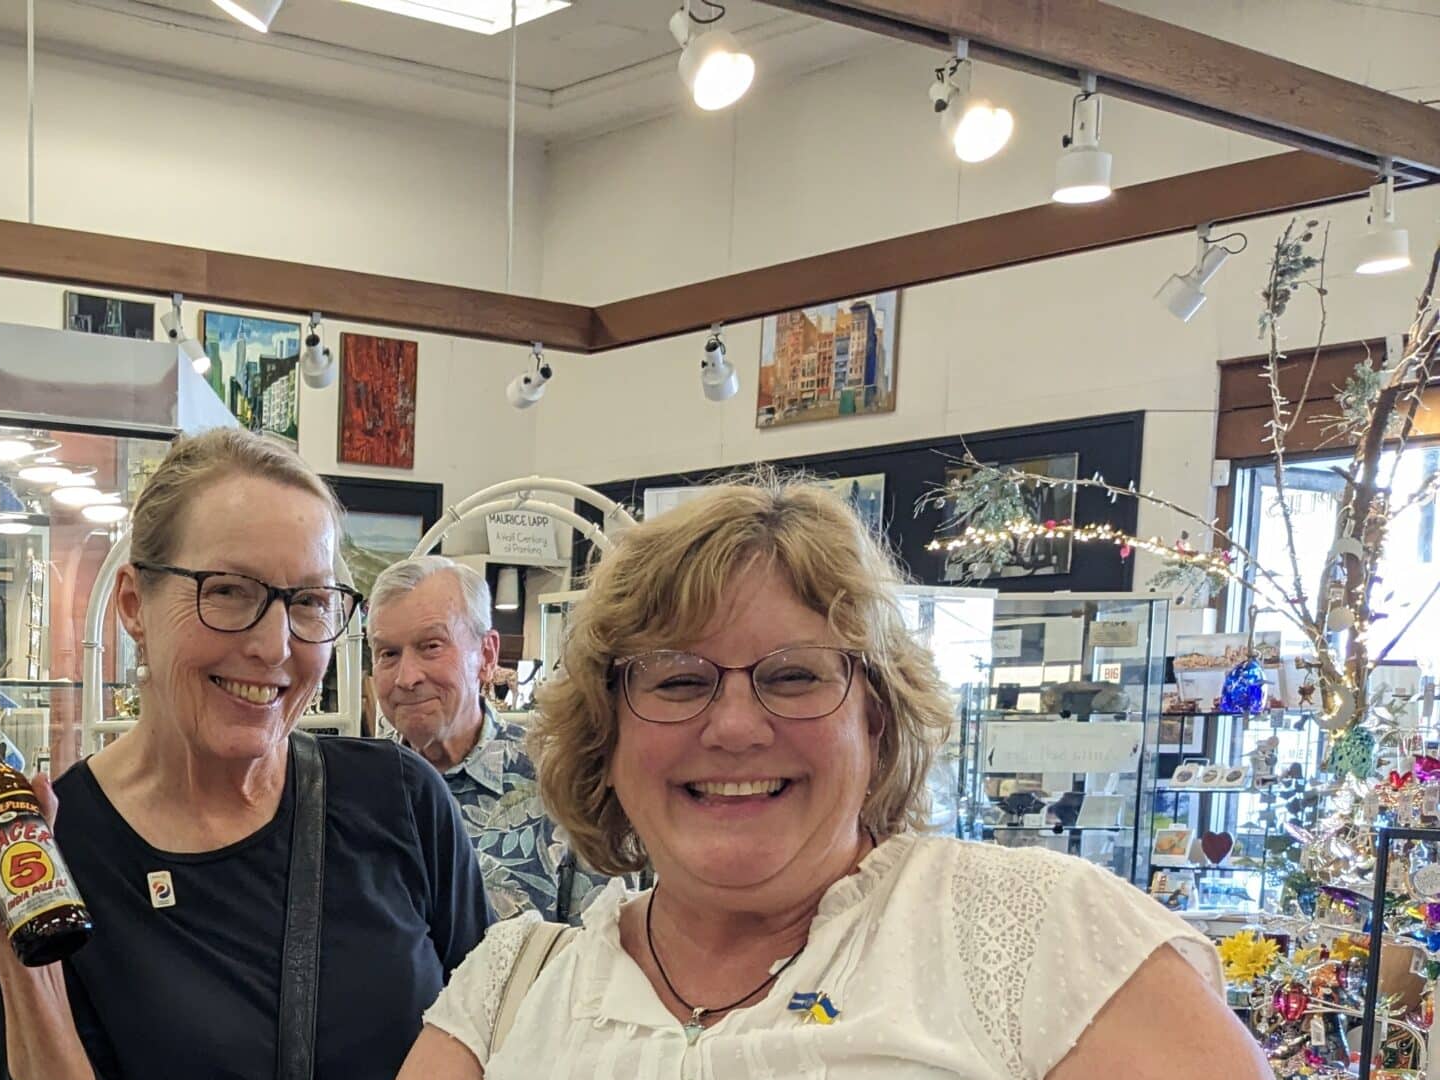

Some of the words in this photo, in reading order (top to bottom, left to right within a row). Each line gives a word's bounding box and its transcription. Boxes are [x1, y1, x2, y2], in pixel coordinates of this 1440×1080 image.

[489, 513, 527, 526] MAURICE
[528, 516, 548, 527] LAPP
[9, 850, 47, 888] 5
